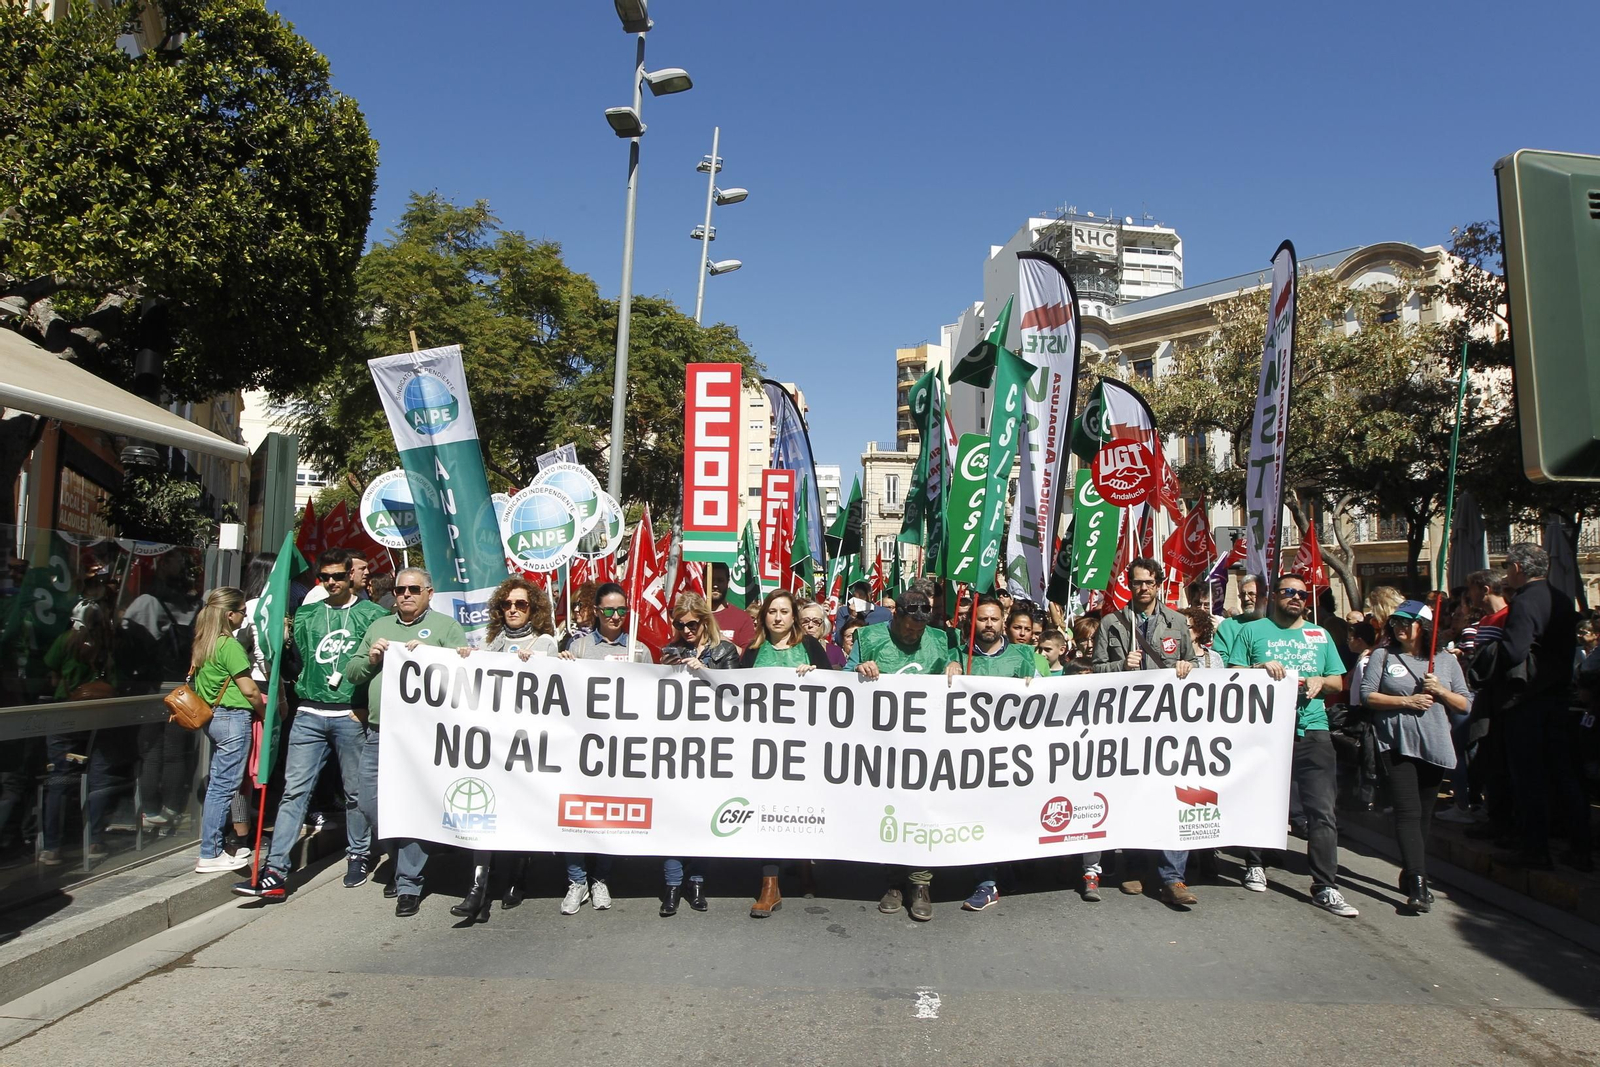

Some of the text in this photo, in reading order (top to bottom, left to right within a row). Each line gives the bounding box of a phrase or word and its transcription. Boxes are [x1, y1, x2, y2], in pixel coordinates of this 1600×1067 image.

[1074, 227, 1115, 248] RHC
[396, 366, 455, 401] SINDICATO PENDIENTE
[693, 371, 731, 527] CCOO
[1100, 442, 1144, 475] UGT
[533, 464, 599, 491] DICATO INDEPENDIENTE
[364, 475, 391, 502] SINDICATO
[1110, 487, 1146, 500] Andalucía
[503, 491, 528, 523] SINDICATO
[528, 486, 575, 513] INDEPENDIENTE
[375, 512, 418, 528] ANP
[434, 455, 470, 584] ANPE
[517, 529, 567, 552] ANPE
[953, 487, 986, 575] CSIF
[1081, 510, 1104, 584] CSIF
[523, 553, 568, 570] ANDALUCÍA
[400, 660, 1275, 734] CONTRA EL DECRETO DE ESCOLARIZACIÓN
[434, 722, 1232, 792] NO AL CIERRE DE UNIDADES PÚBLICAS
[564, 800, 646, 822] CCOO
[719, 809, 755, 824] CSIF
[761, 804, 826, 814] SECTOR
[1047, 801, 1068, 814] UGT
[1073, 803, 1104, 811] Servicios
[1178, 807, 1221, 823] USTEA
[441, 811, 498, 830] ANPE
[760, 825, 825, 834] ANDALUCÍA
[761, 814, 826, 825] EDUCACIÓN
[1179, 822, 1221, 830] INTERSINDICAL
[902, 821, 985, 852] Fapace
[1191, 828, 1220, 836] ANDALUZA
